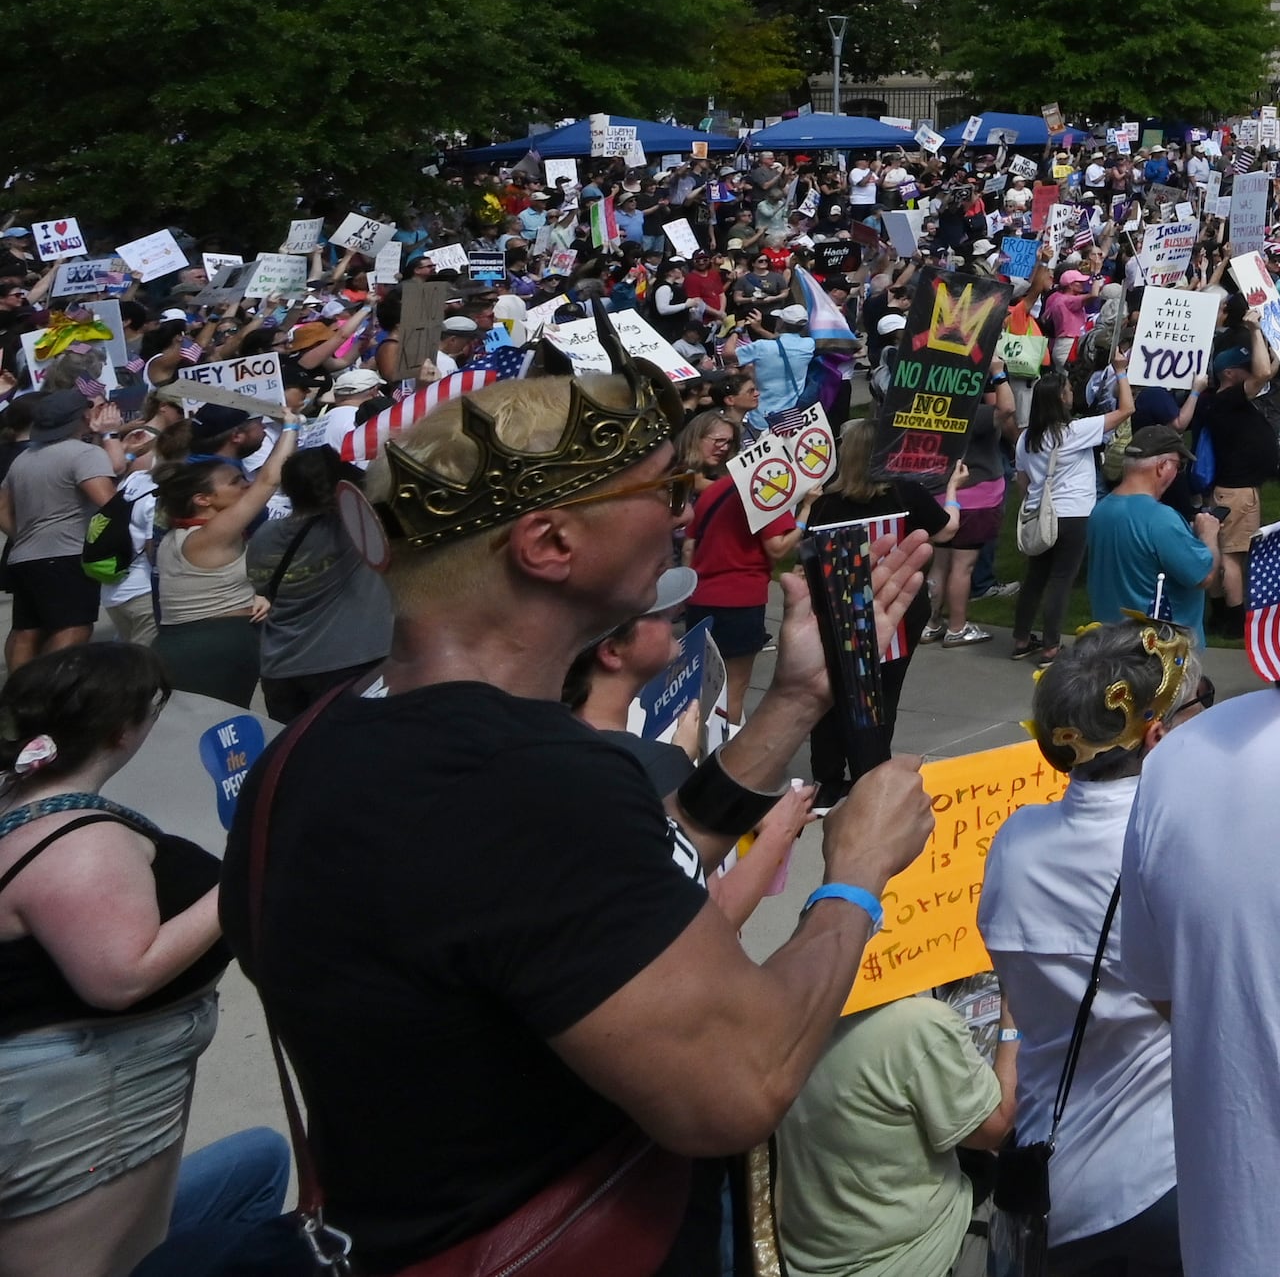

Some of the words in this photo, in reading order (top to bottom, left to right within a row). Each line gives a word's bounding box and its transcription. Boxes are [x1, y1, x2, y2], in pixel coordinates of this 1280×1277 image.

[1011, 162, 1036, 178] KINGS
[1056, 208, 1068, 218] NO
[39, 224, 50, 240] I
[364, 220, 381, 233] NO
[823, 248, 851, 258] Hands
[1002, 238, 1035, 256] PROTE
[1155, 253, 1166, 262] OF
[1164, 297, 1191, 308] ALL
[1157, 308, 1192, 319] THIS
[617, 322, 643, 336] King
[1154, 320, 1190, 332] WILL
[1144, 330, 1196, 344] AFFECT
[628, 341, 661, 357] ctator
[1140, 345, 1203, 380] YOU!
[183, 366, 224, 385] HEY
[229, 359, 276, 382] TACO
[894, 360, 922, 389] NO
[925, 365, 985, 397] KINGS
[265, 379, 278, 390] IS
[913, 394, 948, 415] NO
[894, 414, 966, 432] DICTATORS
[905, 433, 938, 452] NO
[740, 442, 772, 468] 1776
[653, 654, 700, 716] PEOPLE
[217, 723, 239, 749] WE
[226, 750, 246, 772] the
[222, 770, 249, 801] PEO
[952, 797, 1022, 850] plai
[931, 850, 951, 873] is
[880, 881, 983, 934] Corrup
[861, 925, 968, 982] $Trump
